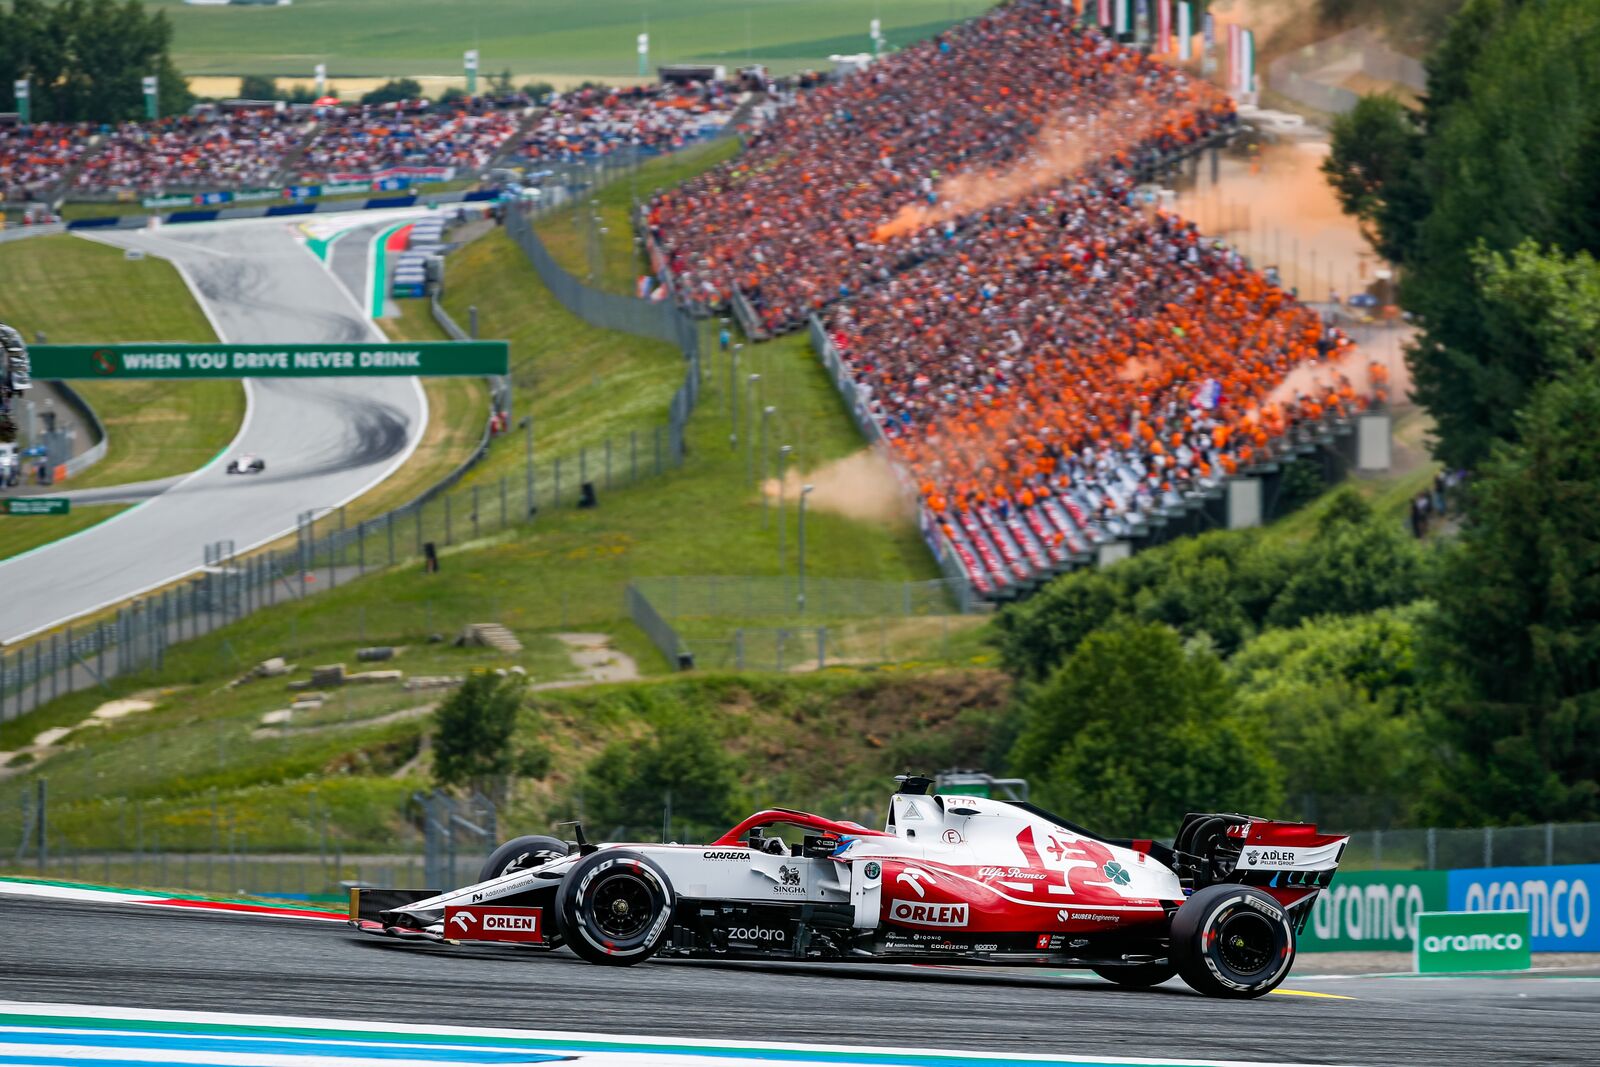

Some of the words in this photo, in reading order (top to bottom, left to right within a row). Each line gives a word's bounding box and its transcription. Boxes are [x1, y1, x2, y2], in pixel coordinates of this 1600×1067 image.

[122, 353, 181, 369] WHEN
[186, 352, 227, 369] YOU
[233, 352, 289, 369] DRIVE
[294, 352, 354, 368] NEVER
[360, 351, 420, 367] DRINK
[703, 852, 751, 860] CARRERA
[1261, 850, 1295, 861] ADLER
[978, 867, 1007, 880] Alfa
[1007, 868, 1048, 880] Romeo
[485, 887, 507, 898] Additive
[507, 879, 534, 891] Industries
[773, 886, 806, 894] SINGHA
[895, 904, 965, 923] ORLEN
[1092, 914, 1120, 922] Engineering
[1313, 884, 1424, 940] aramco
[486, 917, 532, 929] ORLEN
[728, 925, 785, 941] zadara
[1423, 934, 1522, 952] aramco
